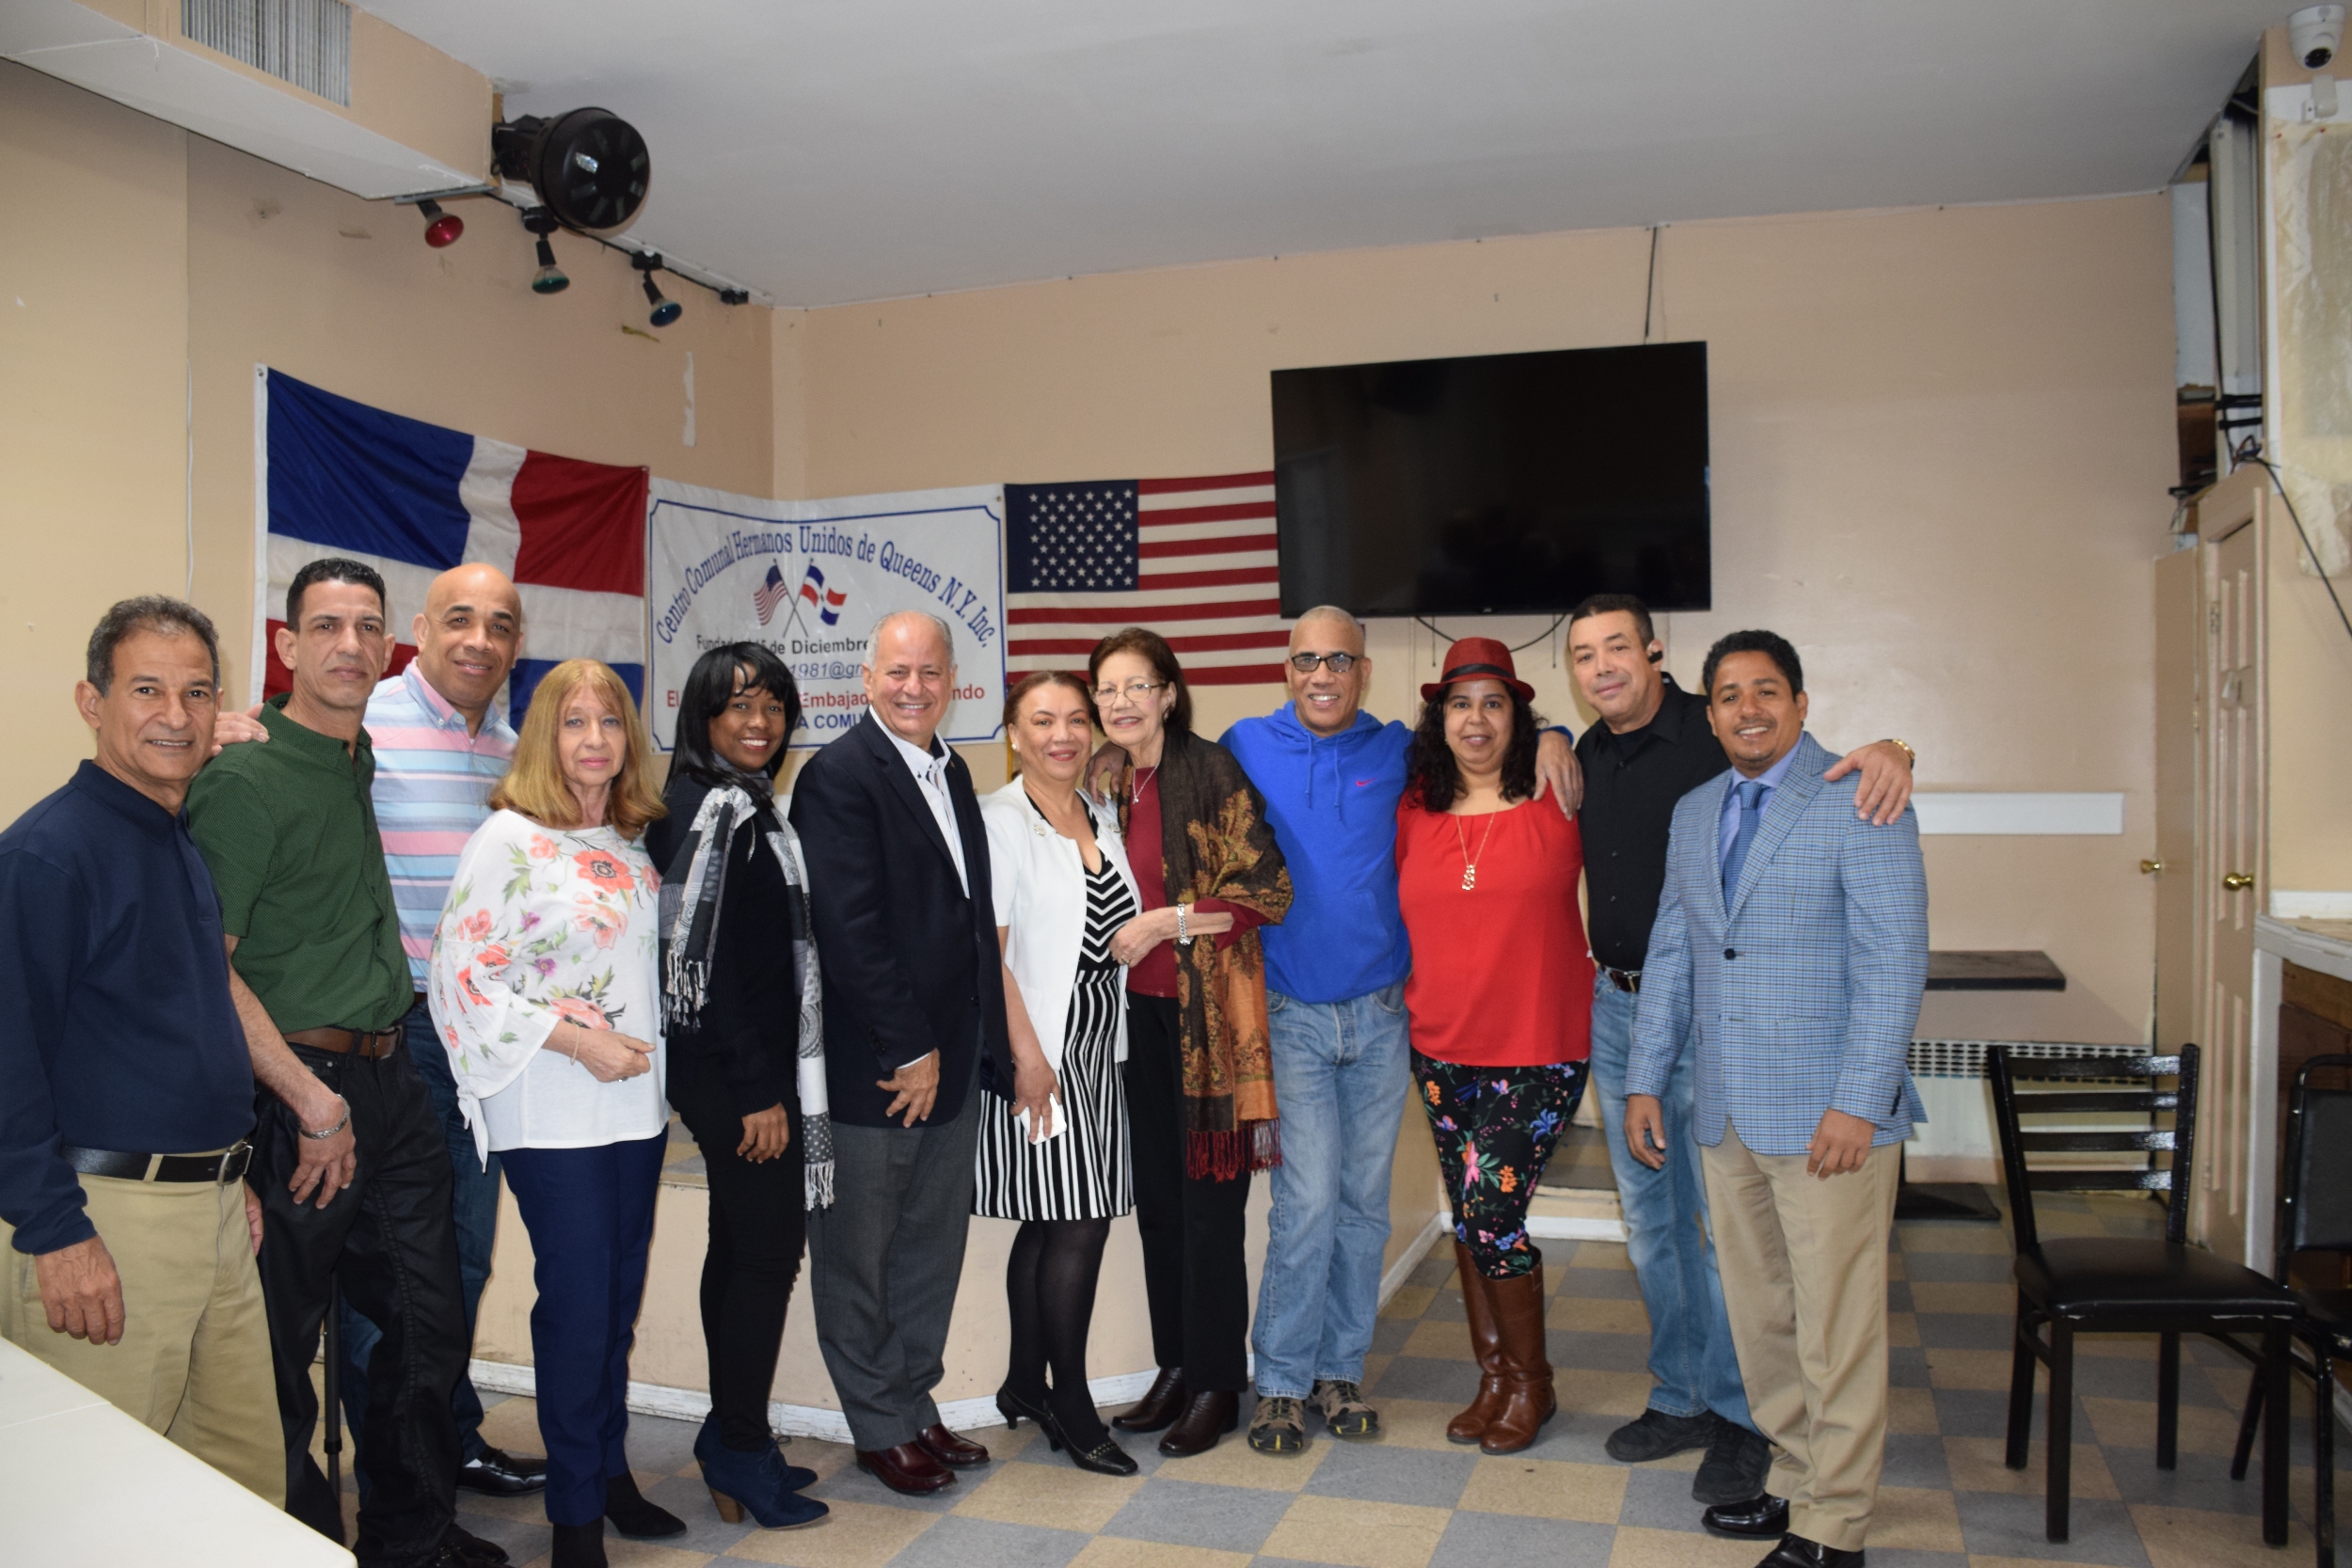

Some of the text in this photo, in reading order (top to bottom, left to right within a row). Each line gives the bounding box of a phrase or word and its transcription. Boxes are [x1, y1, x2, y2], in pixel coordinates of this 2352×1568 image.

[656, 526, 995, 648] Centro Comunal Hermanos Unidos de Queens N.Y. Inc.
[770, 641, 786, 655] de
[791, 638, 868, 656] Diciembre
[667, 689, 679, 707] El
[951, 684, 985, 701] ndo
[814, 712, 865, 730] COMU
